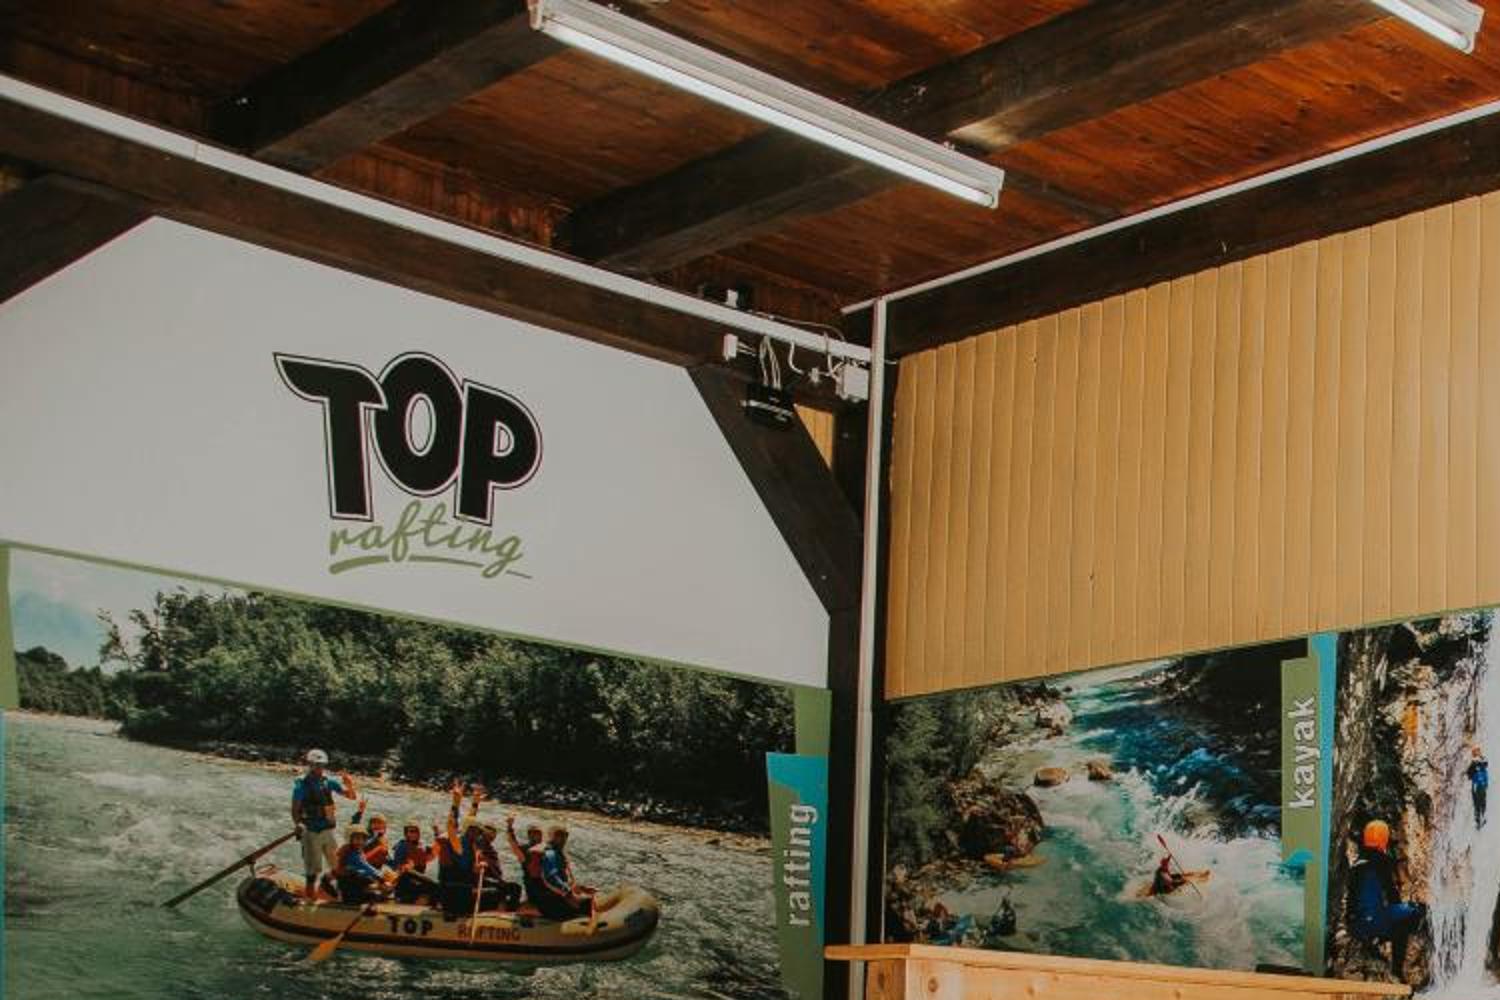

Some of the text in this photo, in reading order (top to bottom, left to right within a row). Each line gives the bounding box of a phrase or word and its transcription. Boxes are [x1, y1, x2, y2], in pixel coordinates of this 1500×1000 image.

[273, 351, 543, 527] TOP
[329, 499, 526, 579] rafting
[1287, 697, 1320, 808] kayak
[783, 804, 818, 926] rafting
[386, 915, 433, 936] TOP
